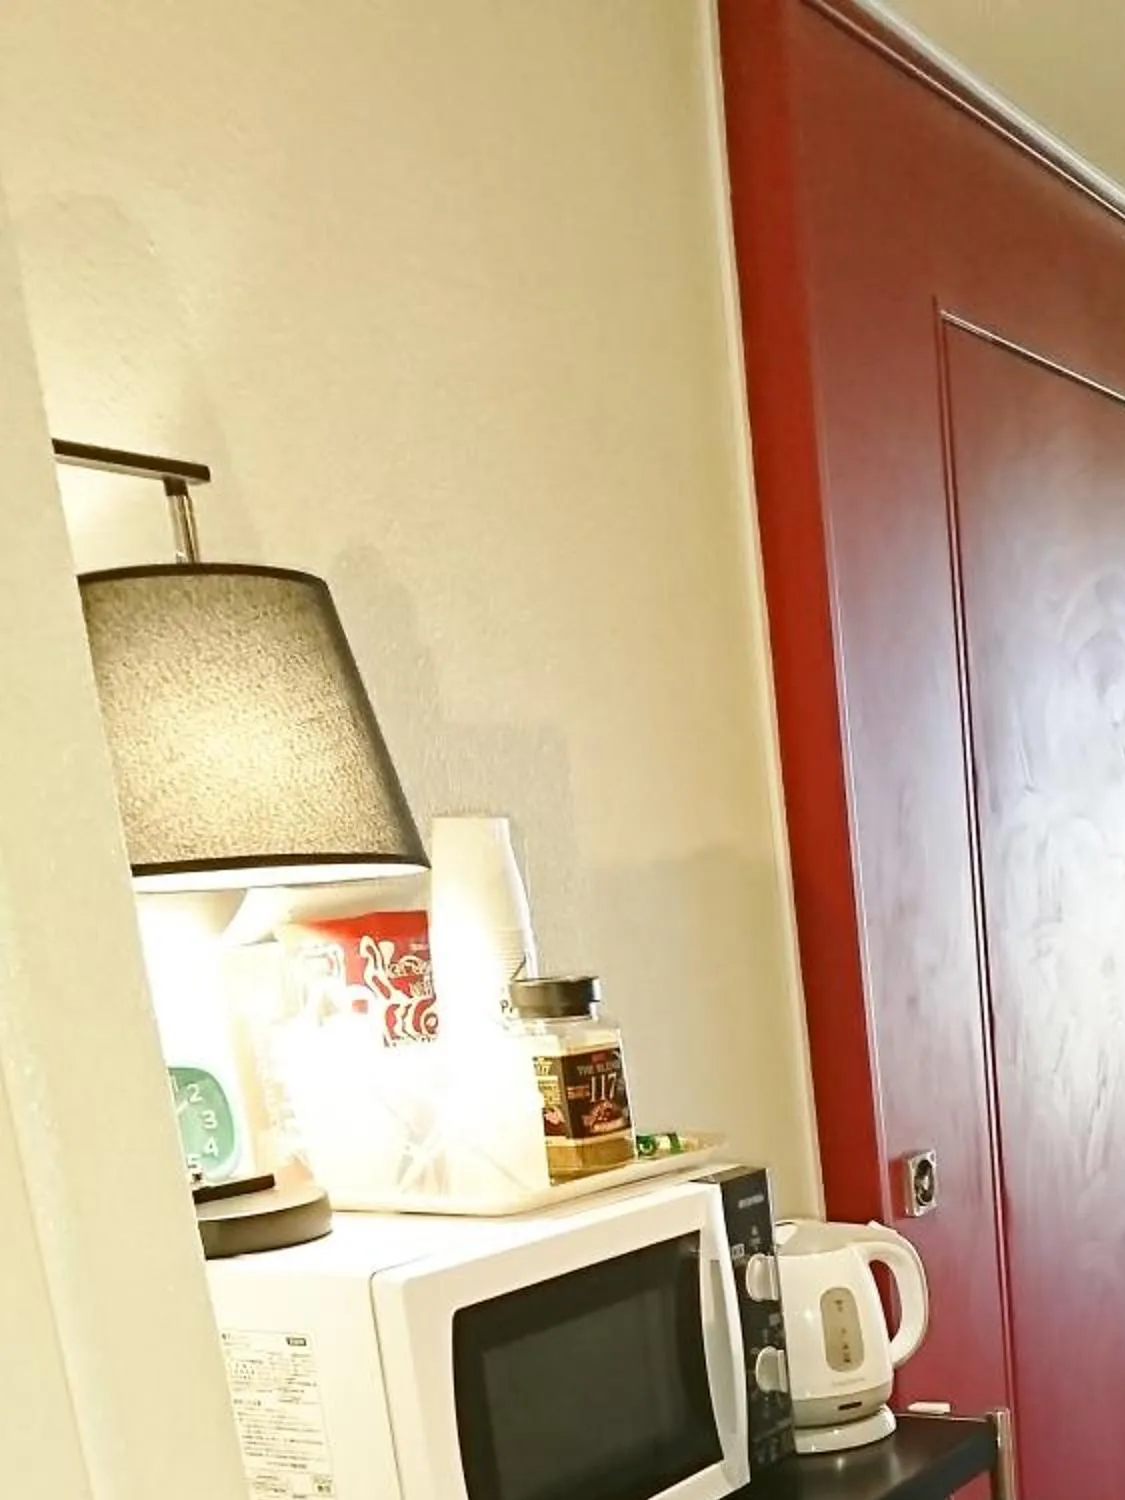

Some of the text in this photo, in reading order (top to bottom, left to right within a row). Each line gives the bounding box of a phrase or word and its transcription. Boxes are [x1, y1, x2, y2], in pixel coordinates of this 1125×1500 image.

[186, 1083, 203, 1102] 2
[590, 1072, 617, 1102] 117
[201, 1109, 218, 1129] 3
[204, 1137, 219, 1157] 4
